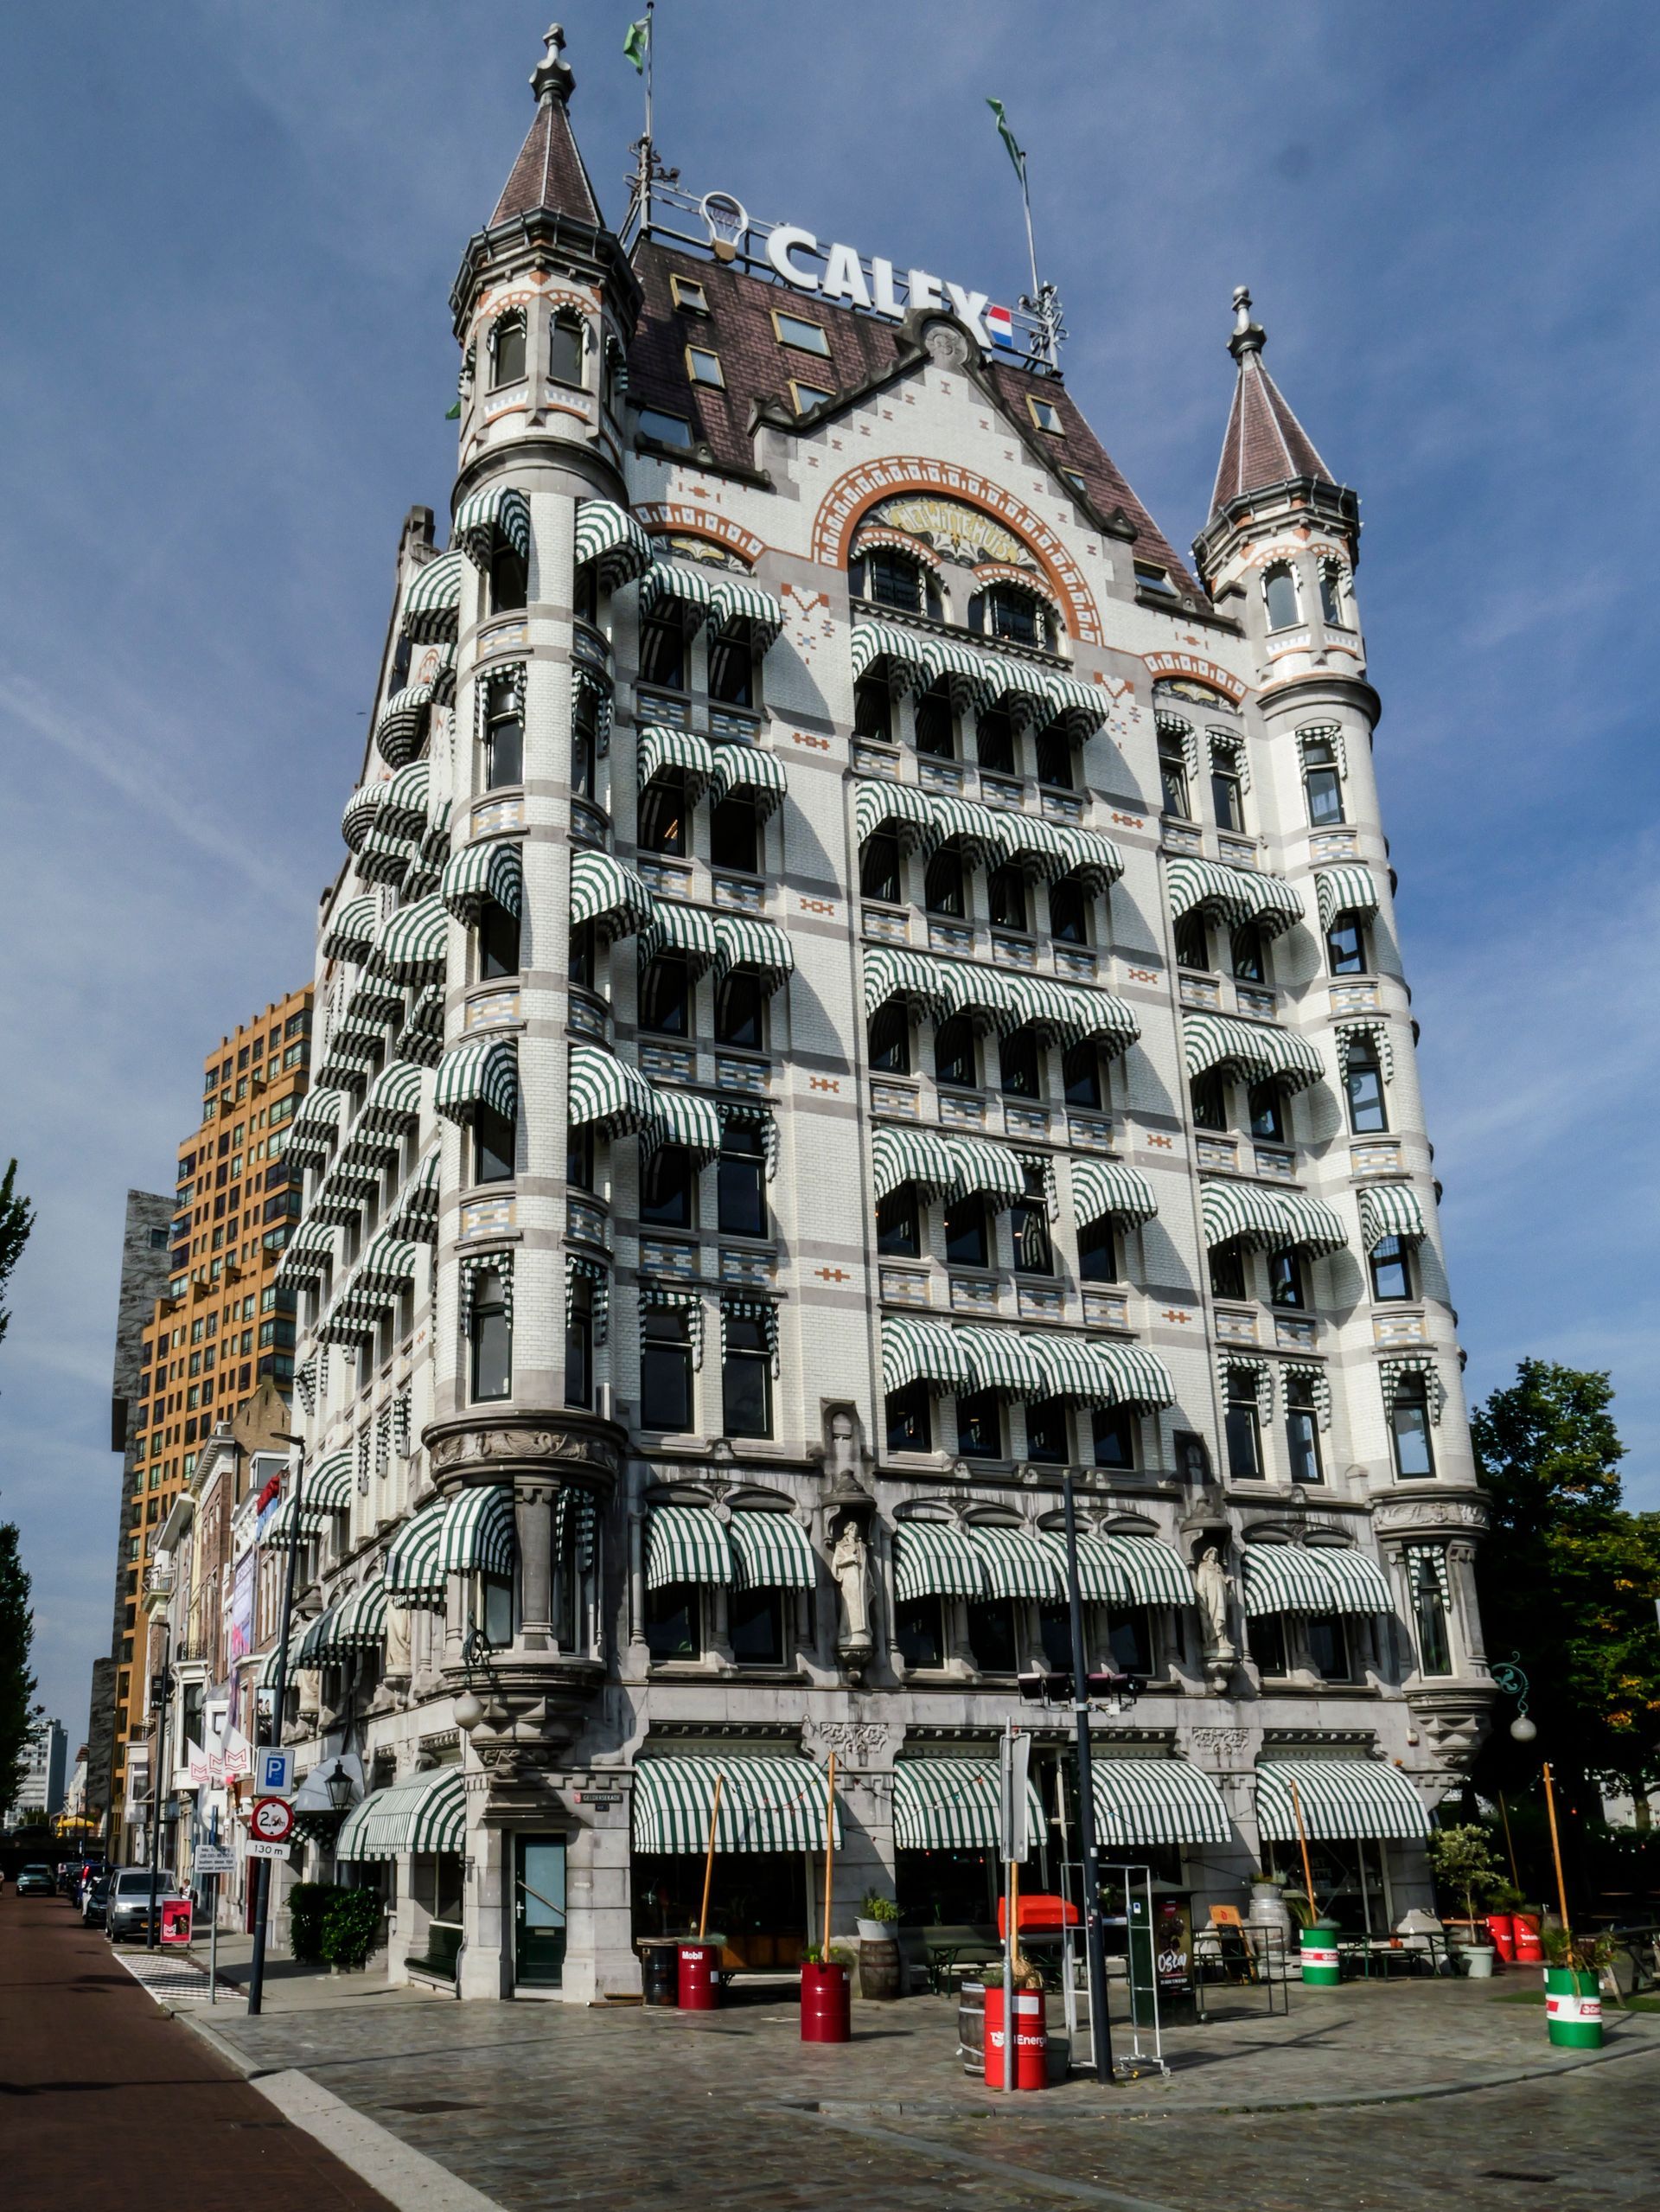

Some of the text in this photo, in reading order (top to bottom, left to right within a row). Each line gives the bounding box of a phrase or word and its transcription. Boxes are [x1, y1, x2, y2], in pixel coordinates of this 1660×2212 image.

[765, 226, 993, 352] CALEX
[897, 504, 1011, 558] HET WITTE HUIS
[254, 1844, 272, 1854] 130
[682, 1951, 703, 1959] Mobil
